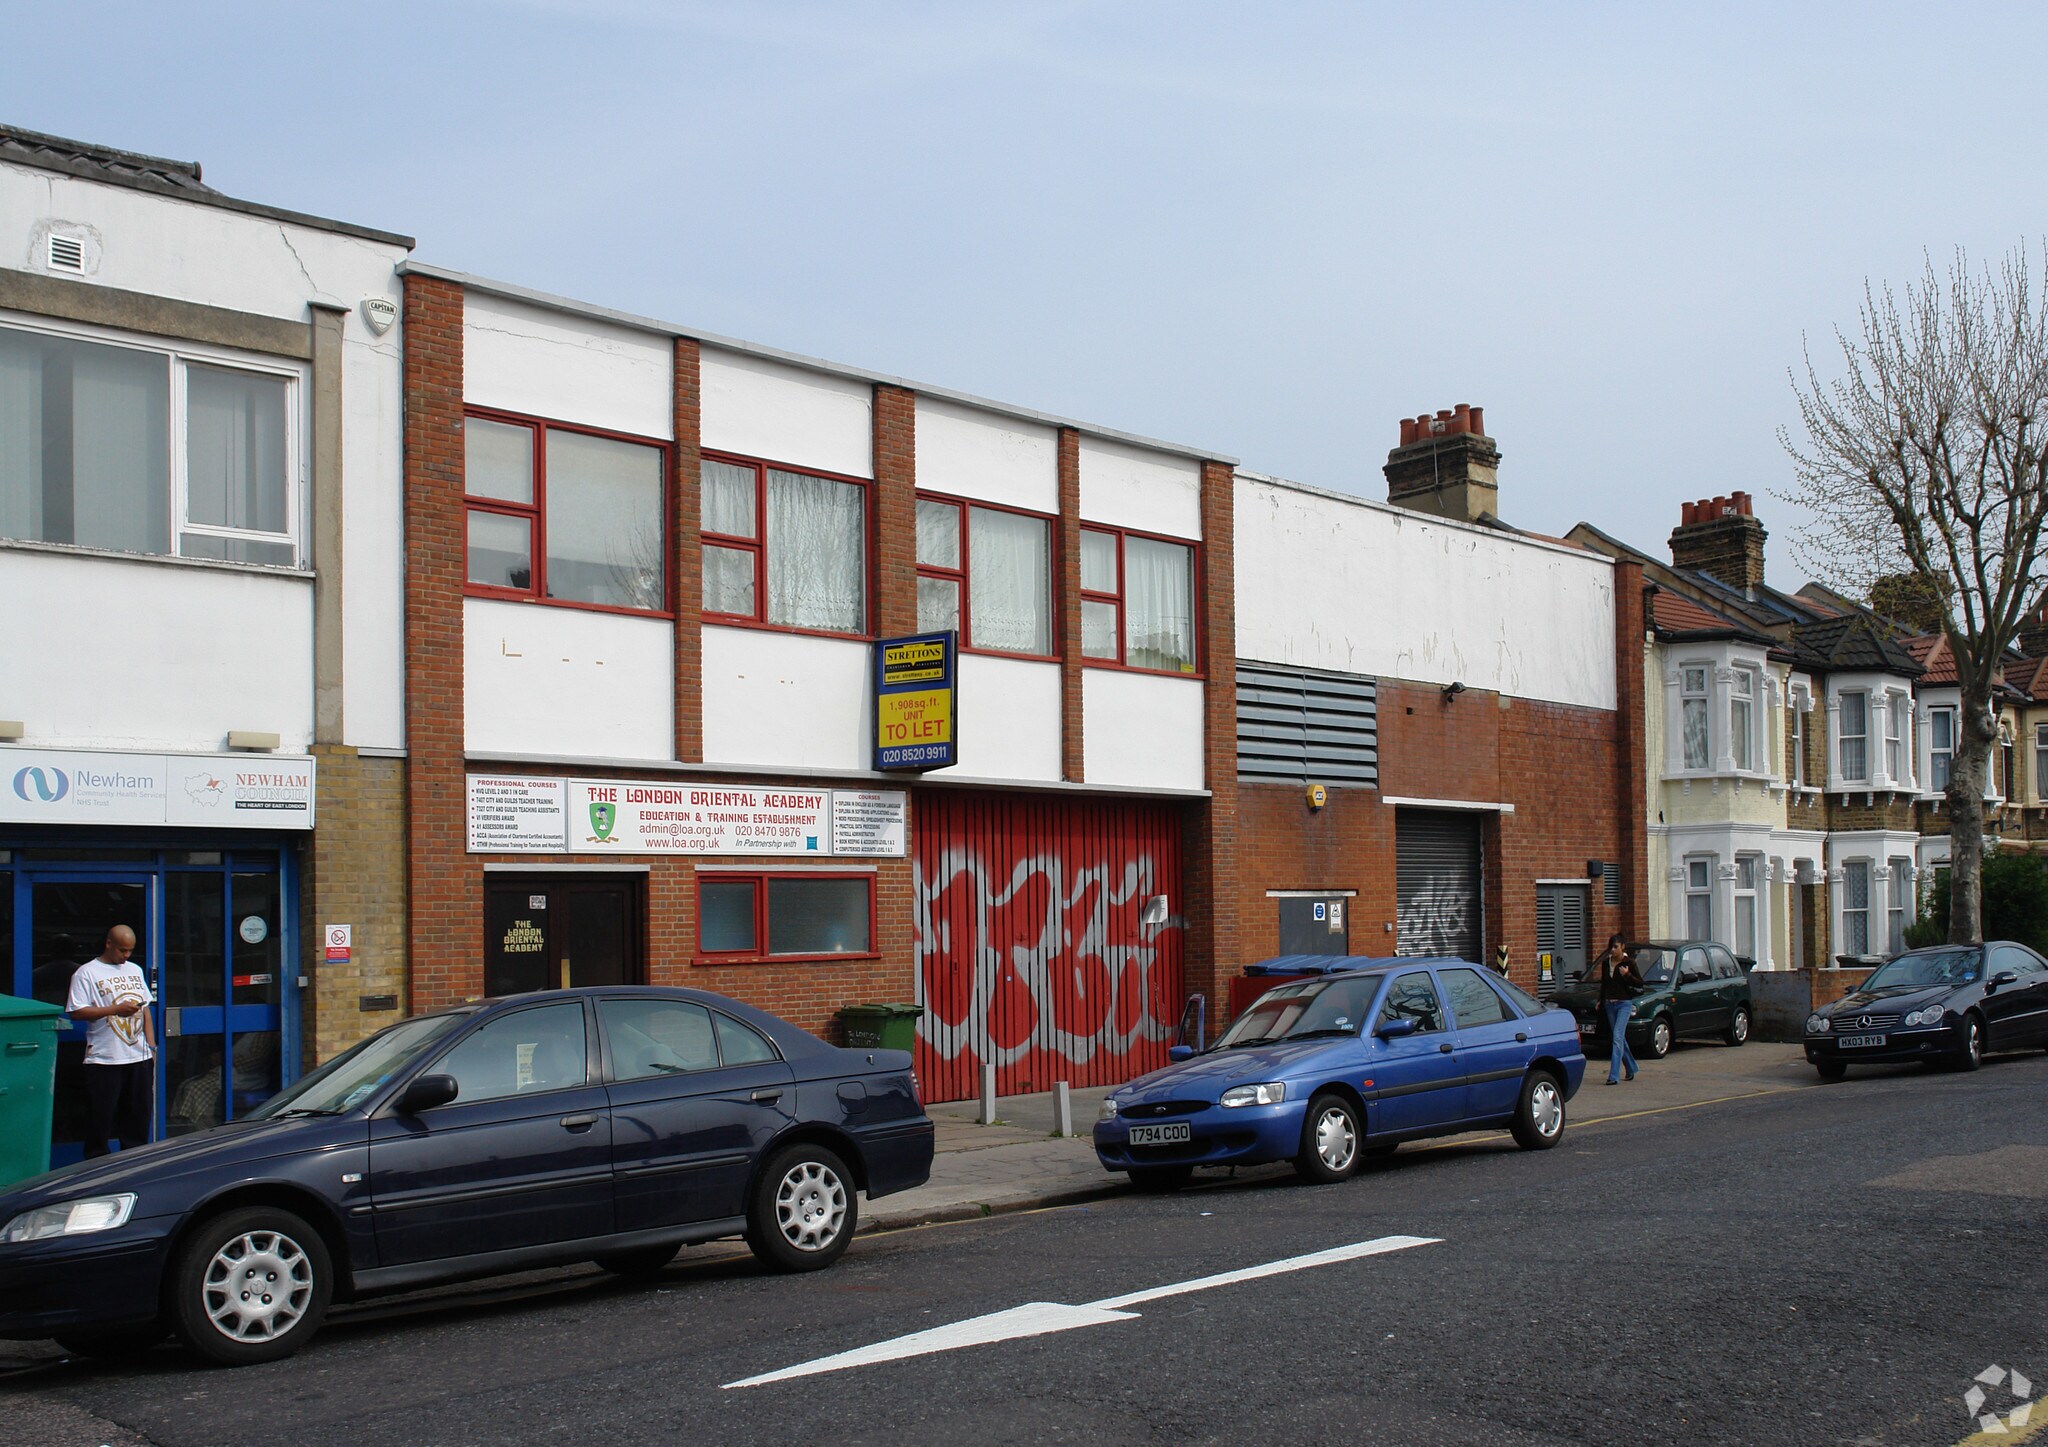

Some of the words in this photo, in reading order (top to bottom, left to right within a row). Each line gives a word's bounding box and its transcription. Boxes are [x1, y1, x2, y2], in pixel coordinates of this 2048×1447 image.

[888, 648, 940, 660] STRETTONS
[904, 710, 924, 720] UNIT
[886, 723, 907, 740] TO
[913, 720, 944, 738] LET
[883, 750, 900, 762] 020
[902, 748, 925, 761] 8520
[926, 746, 946, 759] 9911
[77, 771, 153, 788] Newham
[236, 774, 308, 787] NEWHAM
[235, 788, 307, 800] COUNCIL
[588, 788, 617, 802] THE
[626, 789, 682, 804] LONDON
[691, 792, 756, 807] ORIENTAL
[763, 795, 822, 809] ACADEMY
[640, 811, 690, 821] EDUCATION
[695, 813, 702, 822] &
[707, 813, 748, 822] TRAINING
[753, 814, 816, 824] ESTABLISHMENT
[640, 823, 725, 836] admin@loa.org.uk
[735, 826, 752, 836] 020
[755, 826, 777, 836] 8470
[779, 827, 801, 837] 9876
[645, 837, 720, 851] www.loa.org.uk
[744, 839, 781, 849] Partnership
[508, 928, 541, 936] LONDON
[504, 935, 544, 944] ORIENTAL
[504, 944, 543, 952] ACADEMY
[95, 980, 105, 989] IF
[107, 976, 126, 984] YOU
[99, 988, 113, 997] DA
[1842, 1038, 1862, 1046] HX03
[1865, 1036, 1882, 1045] RYB
[1131, 1128, 1160, 1142] T794
